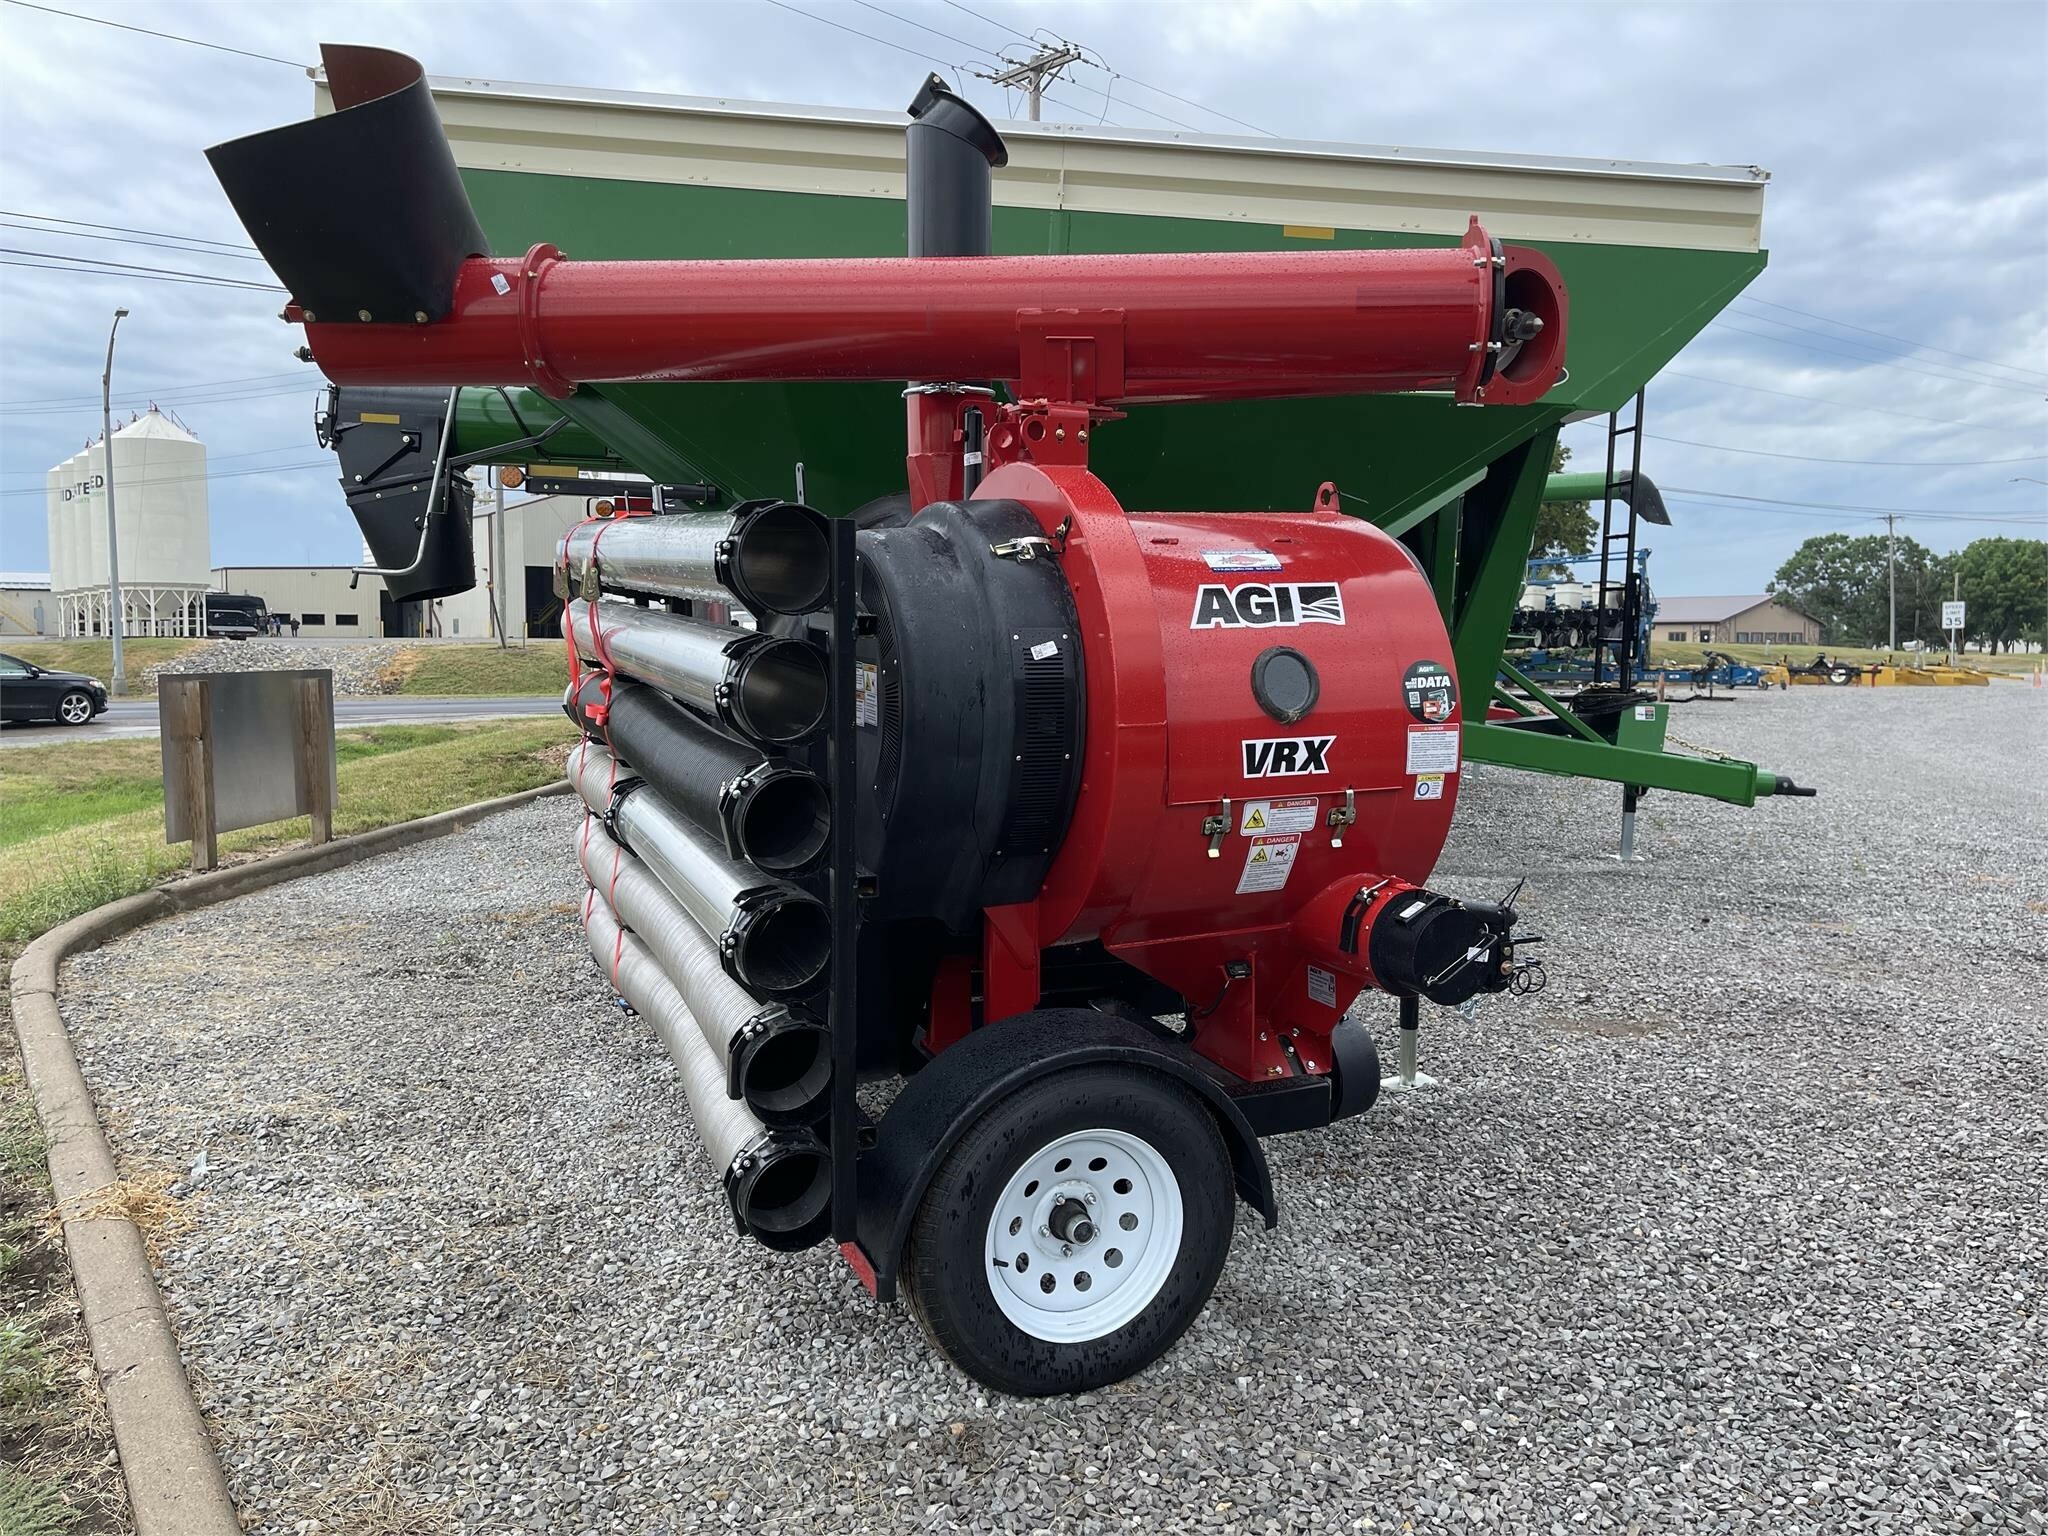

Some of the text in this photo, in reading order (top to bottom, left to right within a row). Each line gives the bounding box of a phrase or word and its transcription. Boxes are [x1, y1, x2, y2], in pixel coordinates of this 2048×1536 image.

[1195, 586, 1296, 625] AGI
[1418, 676, 1451, 688] DATA
[1245, 739, 1332, 775] VRX
[1266, 836, 1295, 844] DANGER
